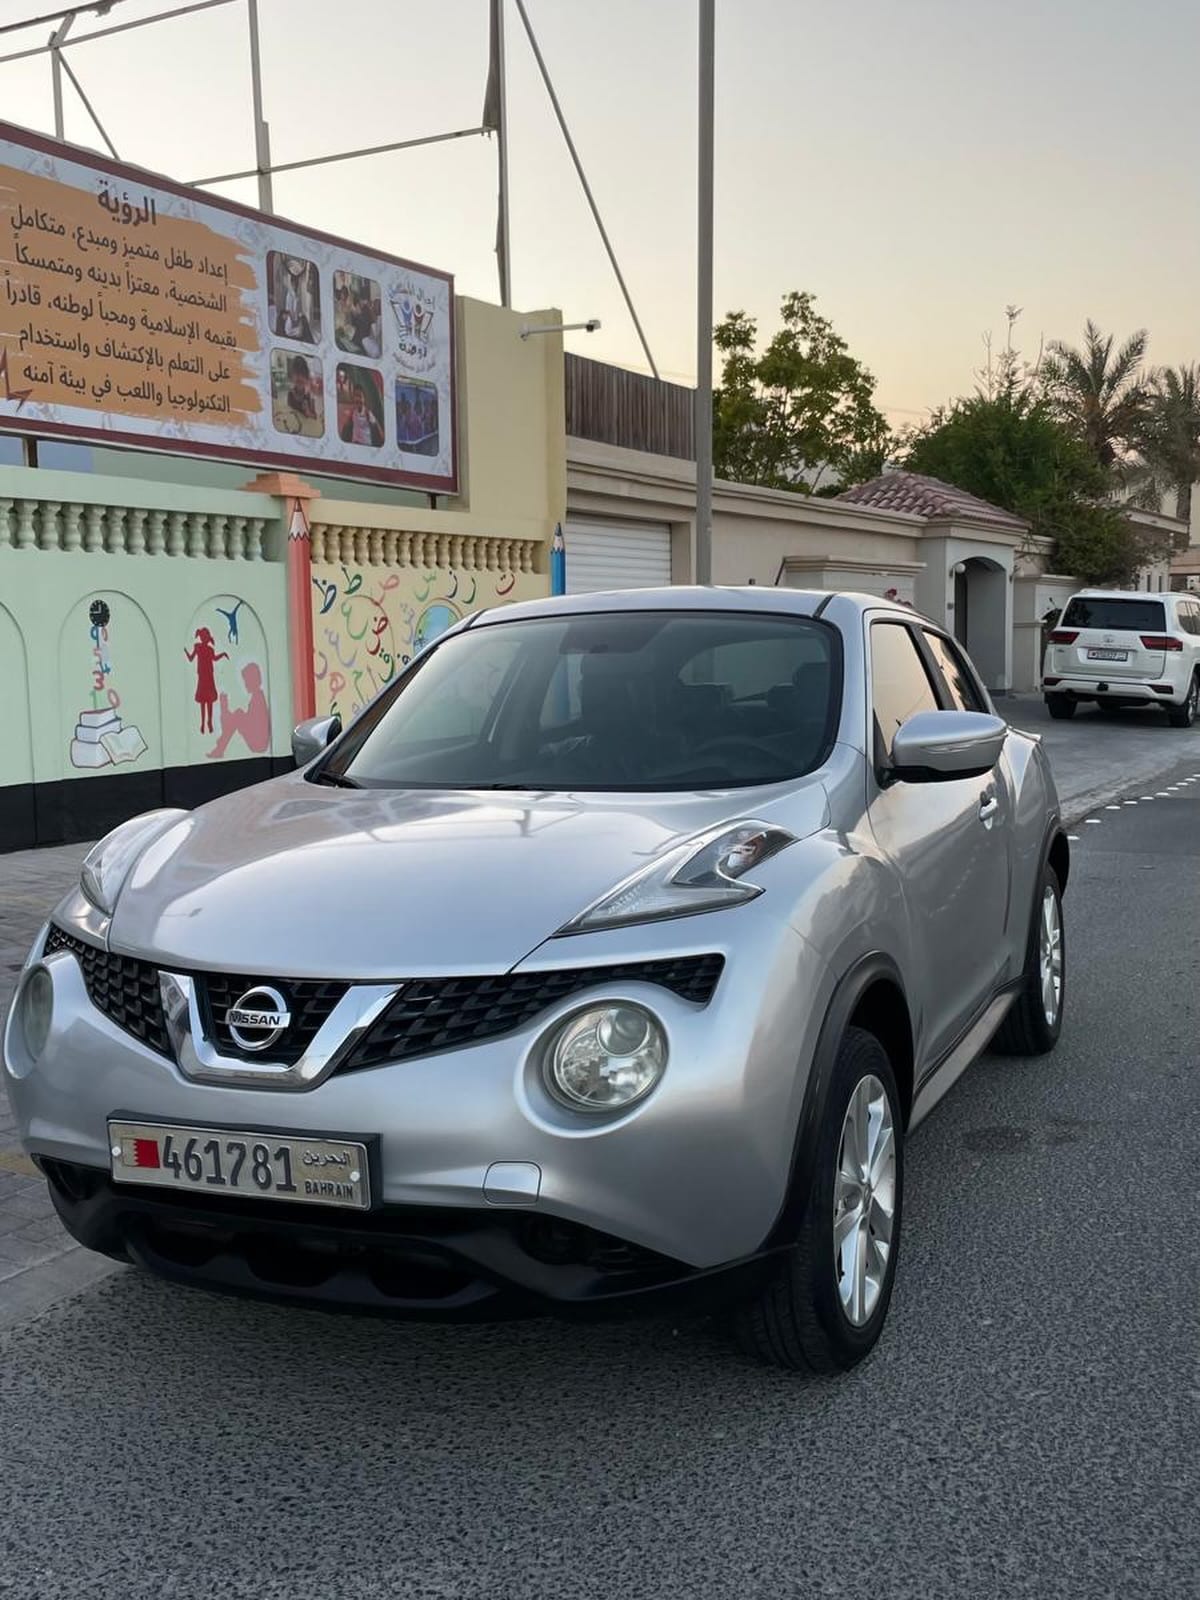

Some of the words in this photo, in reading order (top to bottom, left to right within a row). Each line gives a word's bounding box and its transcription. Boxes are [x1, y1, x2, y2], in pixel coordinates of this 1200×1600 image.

[97, 179, 157, 227] الرؤية
[10, 203, 66, 236] متكامل
[121, 236, 160, 260] متميز
[164, 247, 194, 270] طفل
[87, 266, 121, 293] بدينه
[198, 256, 228, 287] إعداد
[139, 308, 200, 345] الإسلامية
[18, 322, 90, 359] واستخدام
[203, 328, 237, 353] بقيمه
[22, 360, 54, 385] آمنه
[167, 352, 204, 379] التعلم
[208, 360, 231, 382] على
[59, 364, 86, 395] بيئة
[91, 373, 112, 402] في
[116, 380, 163, 407] واللعب
[167, 384, 231, 413] التكنولوجيا
[92, 671, 105, 691] 3
[229, 1010, 281, 1026] NISSAN
[162, 1135, 297, 1193] 461781
[303, 1150, 351, 1169] البحرين
[304, 1180, 353, 1199] BAHRAIN
